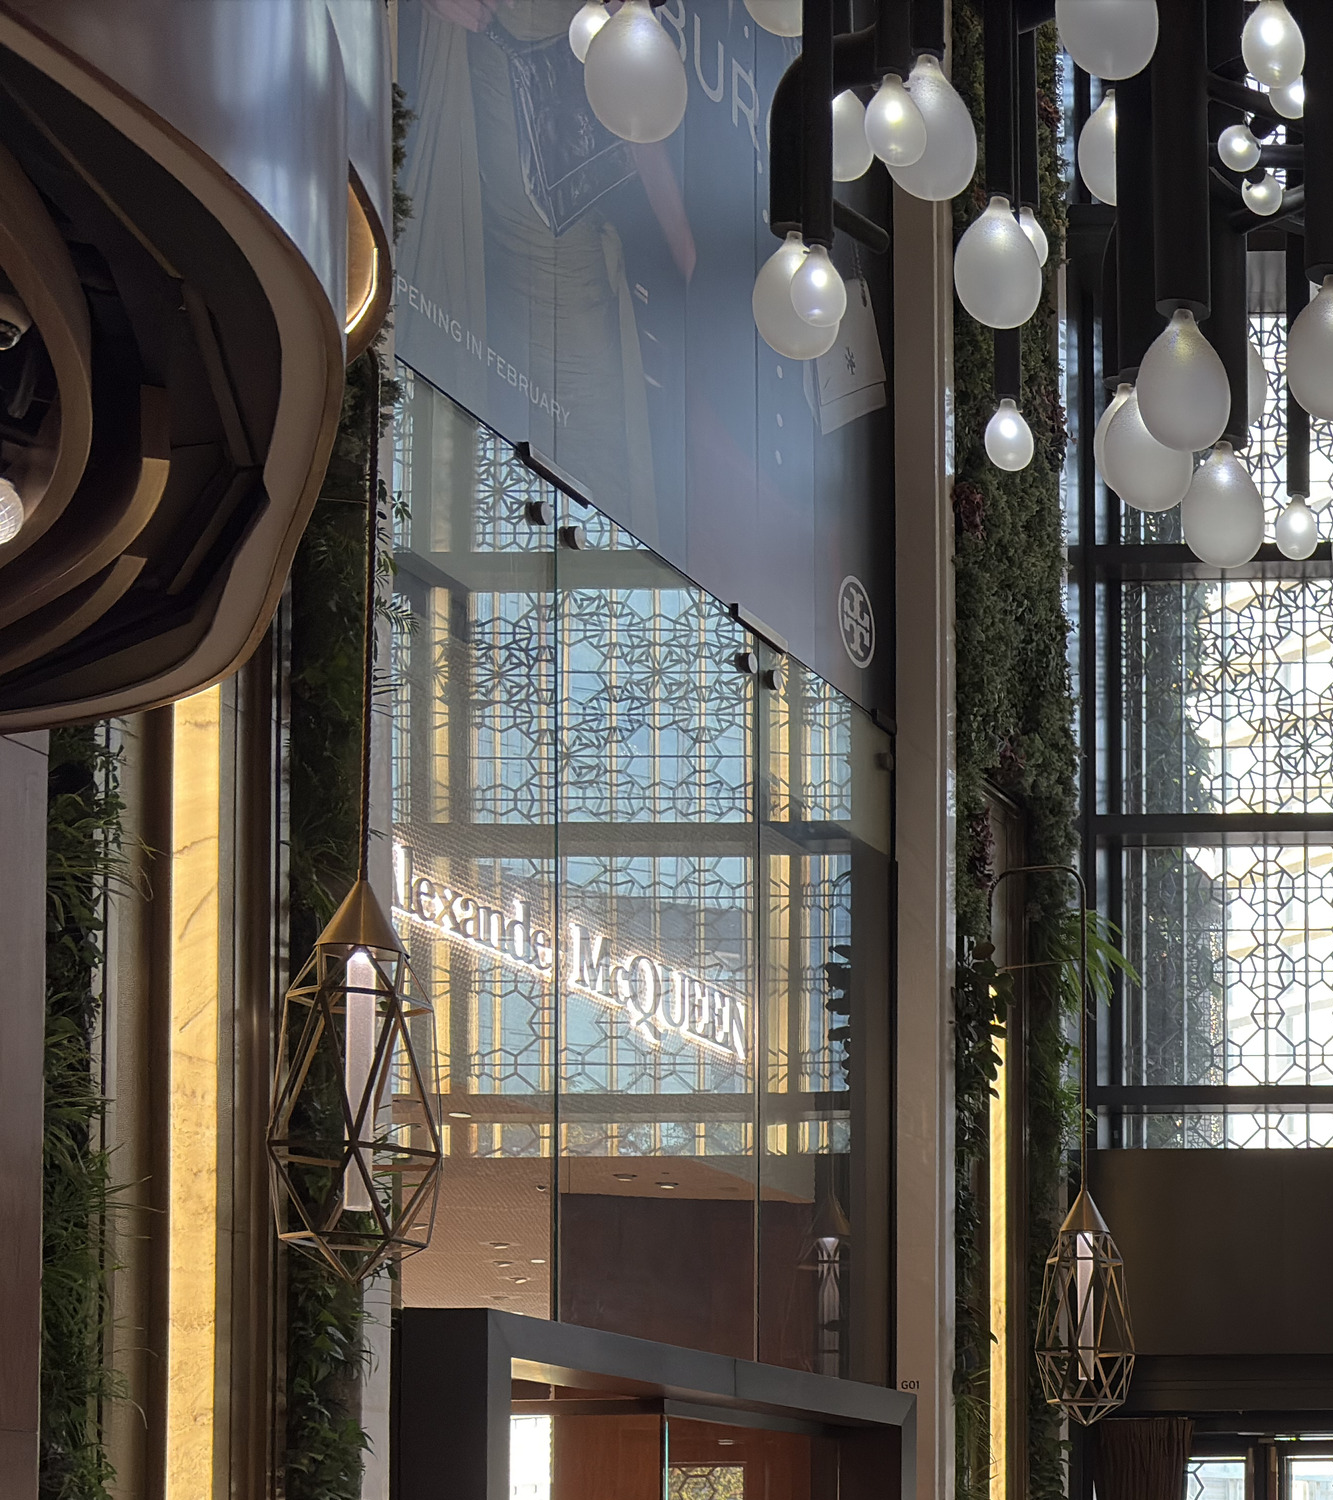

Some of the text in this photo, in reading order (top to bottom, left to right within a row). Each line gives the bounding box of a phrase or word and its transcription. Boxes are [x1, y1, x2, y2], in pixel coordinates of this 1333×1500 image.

[396, 275, 570, 428] PENING IN FEBRUARY
[393, 844, 553, 971] lexande
[901, 1380, 920, 1390] G01
